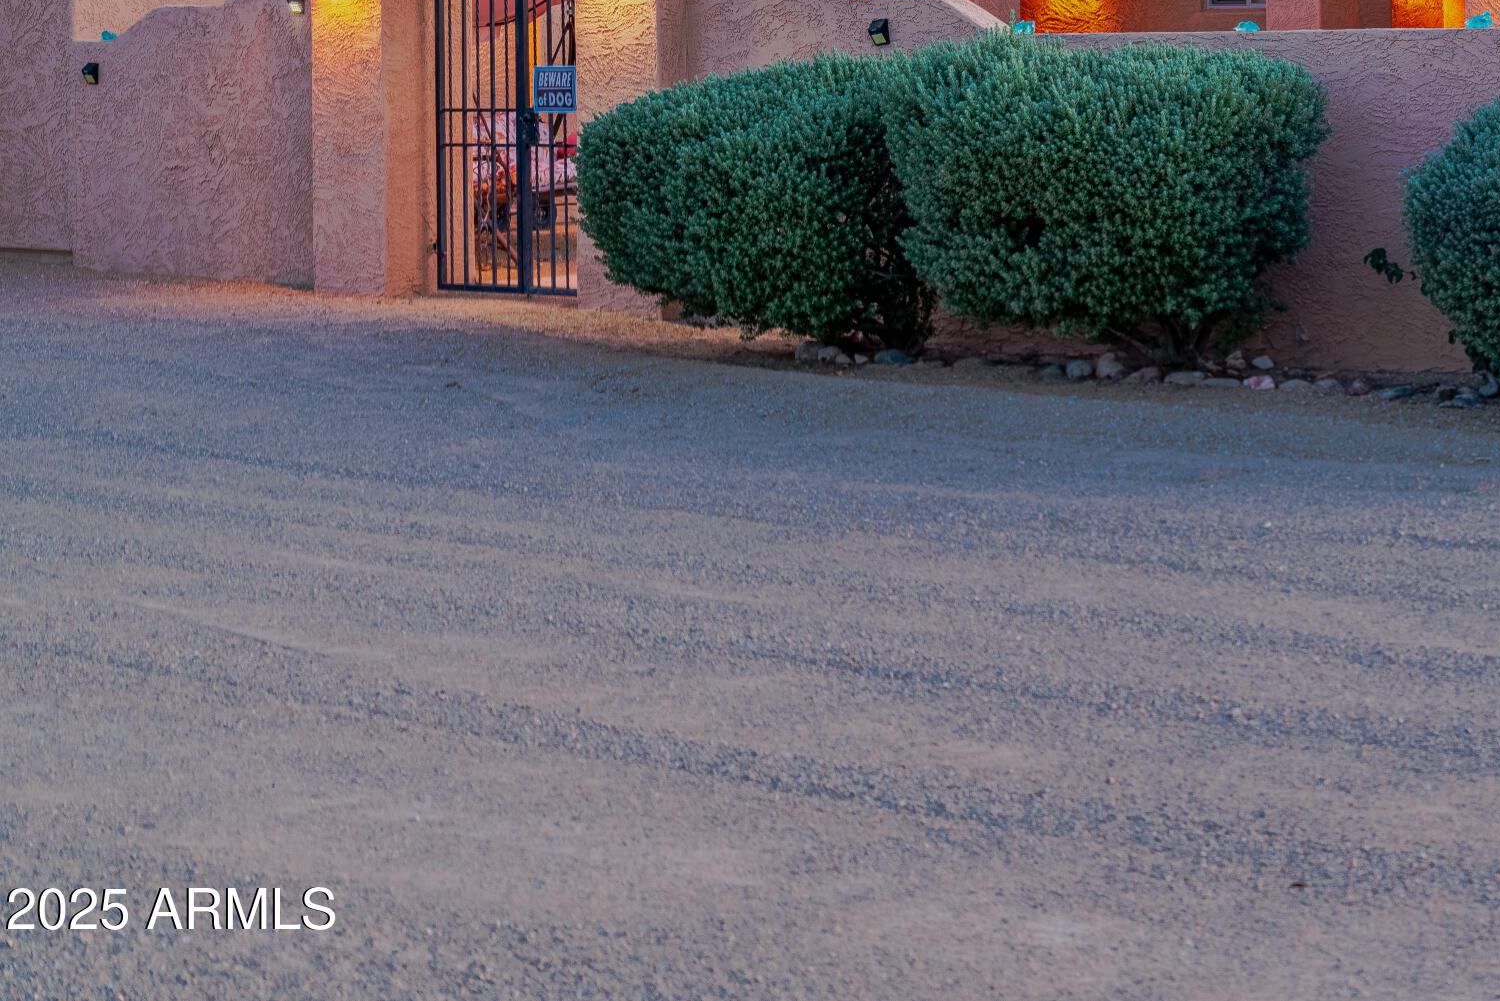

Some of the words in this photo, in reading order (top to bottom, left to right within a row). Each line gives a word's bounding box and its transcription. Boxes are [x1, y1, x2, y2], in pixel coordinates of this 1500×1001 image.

[538, 71, 572, 87] BEWARE
[538, 92, 547, 106] of
[548, 92, 573, 107] DOG
